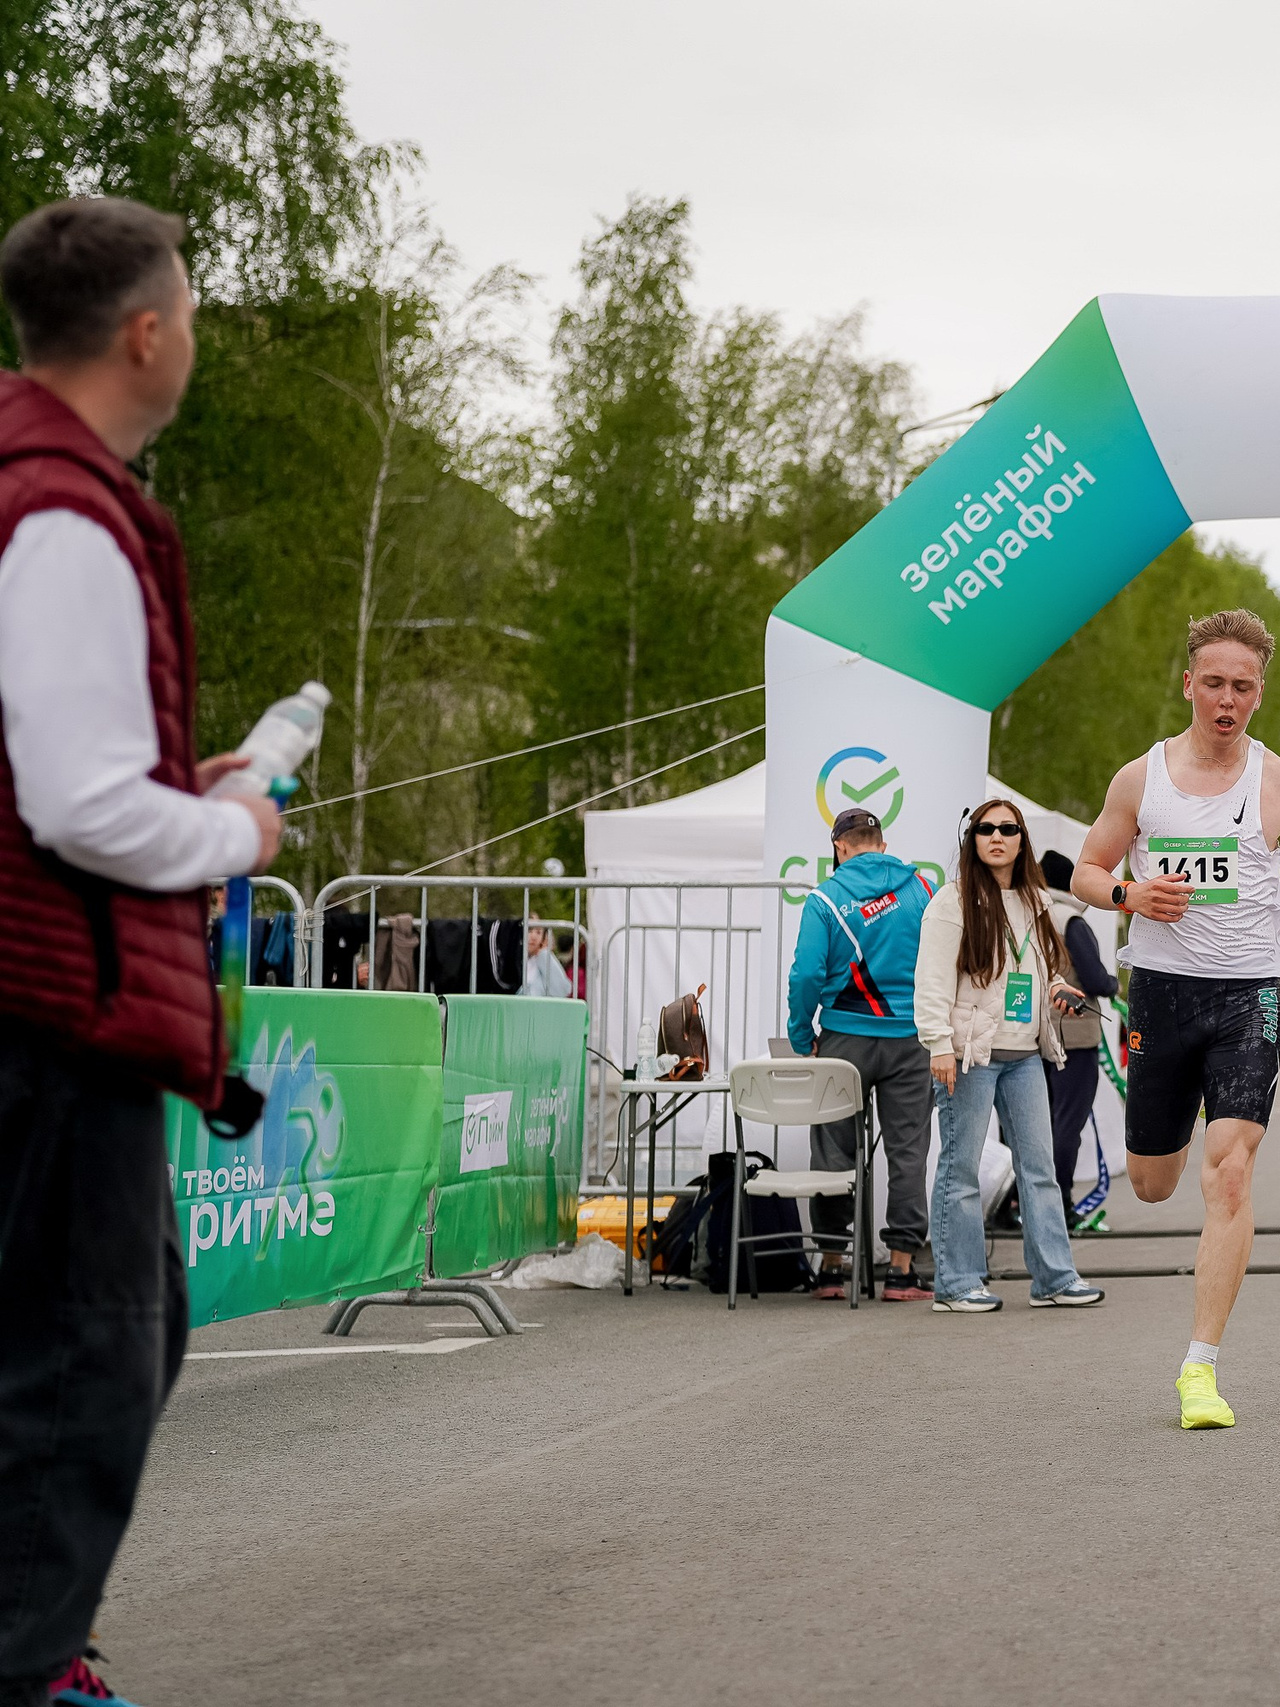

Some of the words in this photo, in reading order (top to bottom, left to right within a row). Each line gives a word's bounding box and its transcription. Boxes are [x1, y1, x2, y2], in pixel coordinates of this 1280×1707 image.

[900, 423, 1068, 594] зелёный
[927, 460, 1097, 626] марафон
[1158, 857, 1229, 883] 1415
[864, 894, 892, 916] TIME
[182, 1155, 265, 1197] твоём
[188, 1191, 336, 1268] ритме
